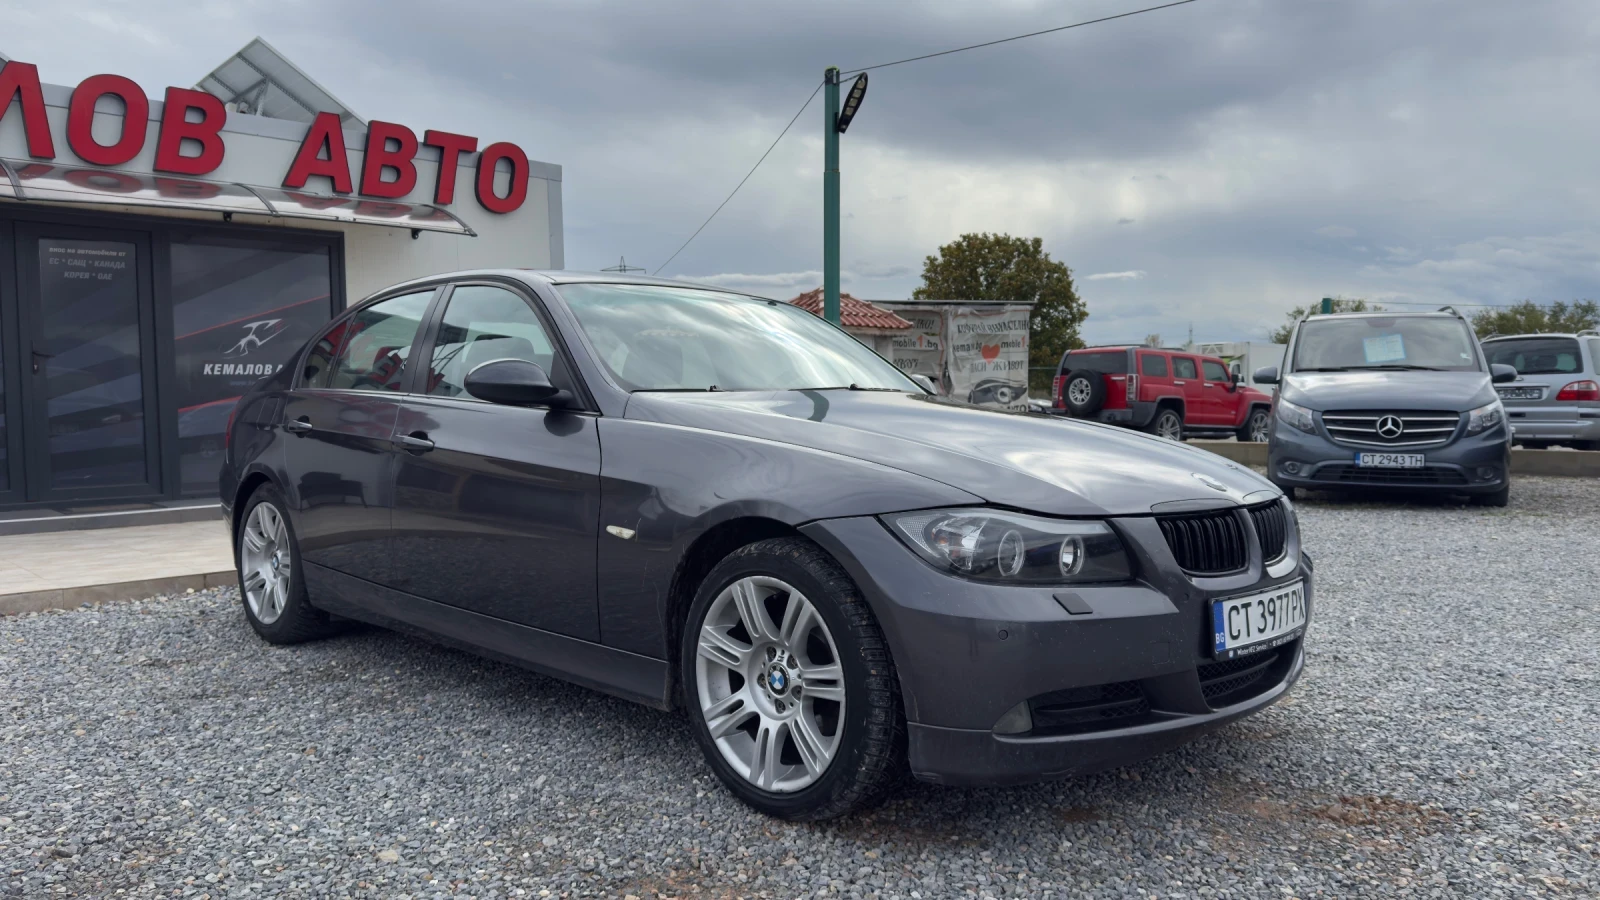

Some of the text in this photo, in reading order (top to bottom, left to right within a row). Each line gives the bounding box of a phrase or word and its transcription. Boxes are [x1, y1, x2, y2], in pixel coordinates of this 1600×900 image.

[281, 111, 529, 214] АВТО
[67, 259, 87, 268] САЩ
[94, 260, 126, 270] КАНАДА
[64, 271, 113, 281] КОРЕЯ ОАЕ
[203, 363, 273, 375] КЕМАЛОВ
[1378, 454, 1406, 466] 2943
[1257, 592, 1290, 634] 3977
[1215, 632, 1225, 644] BG
